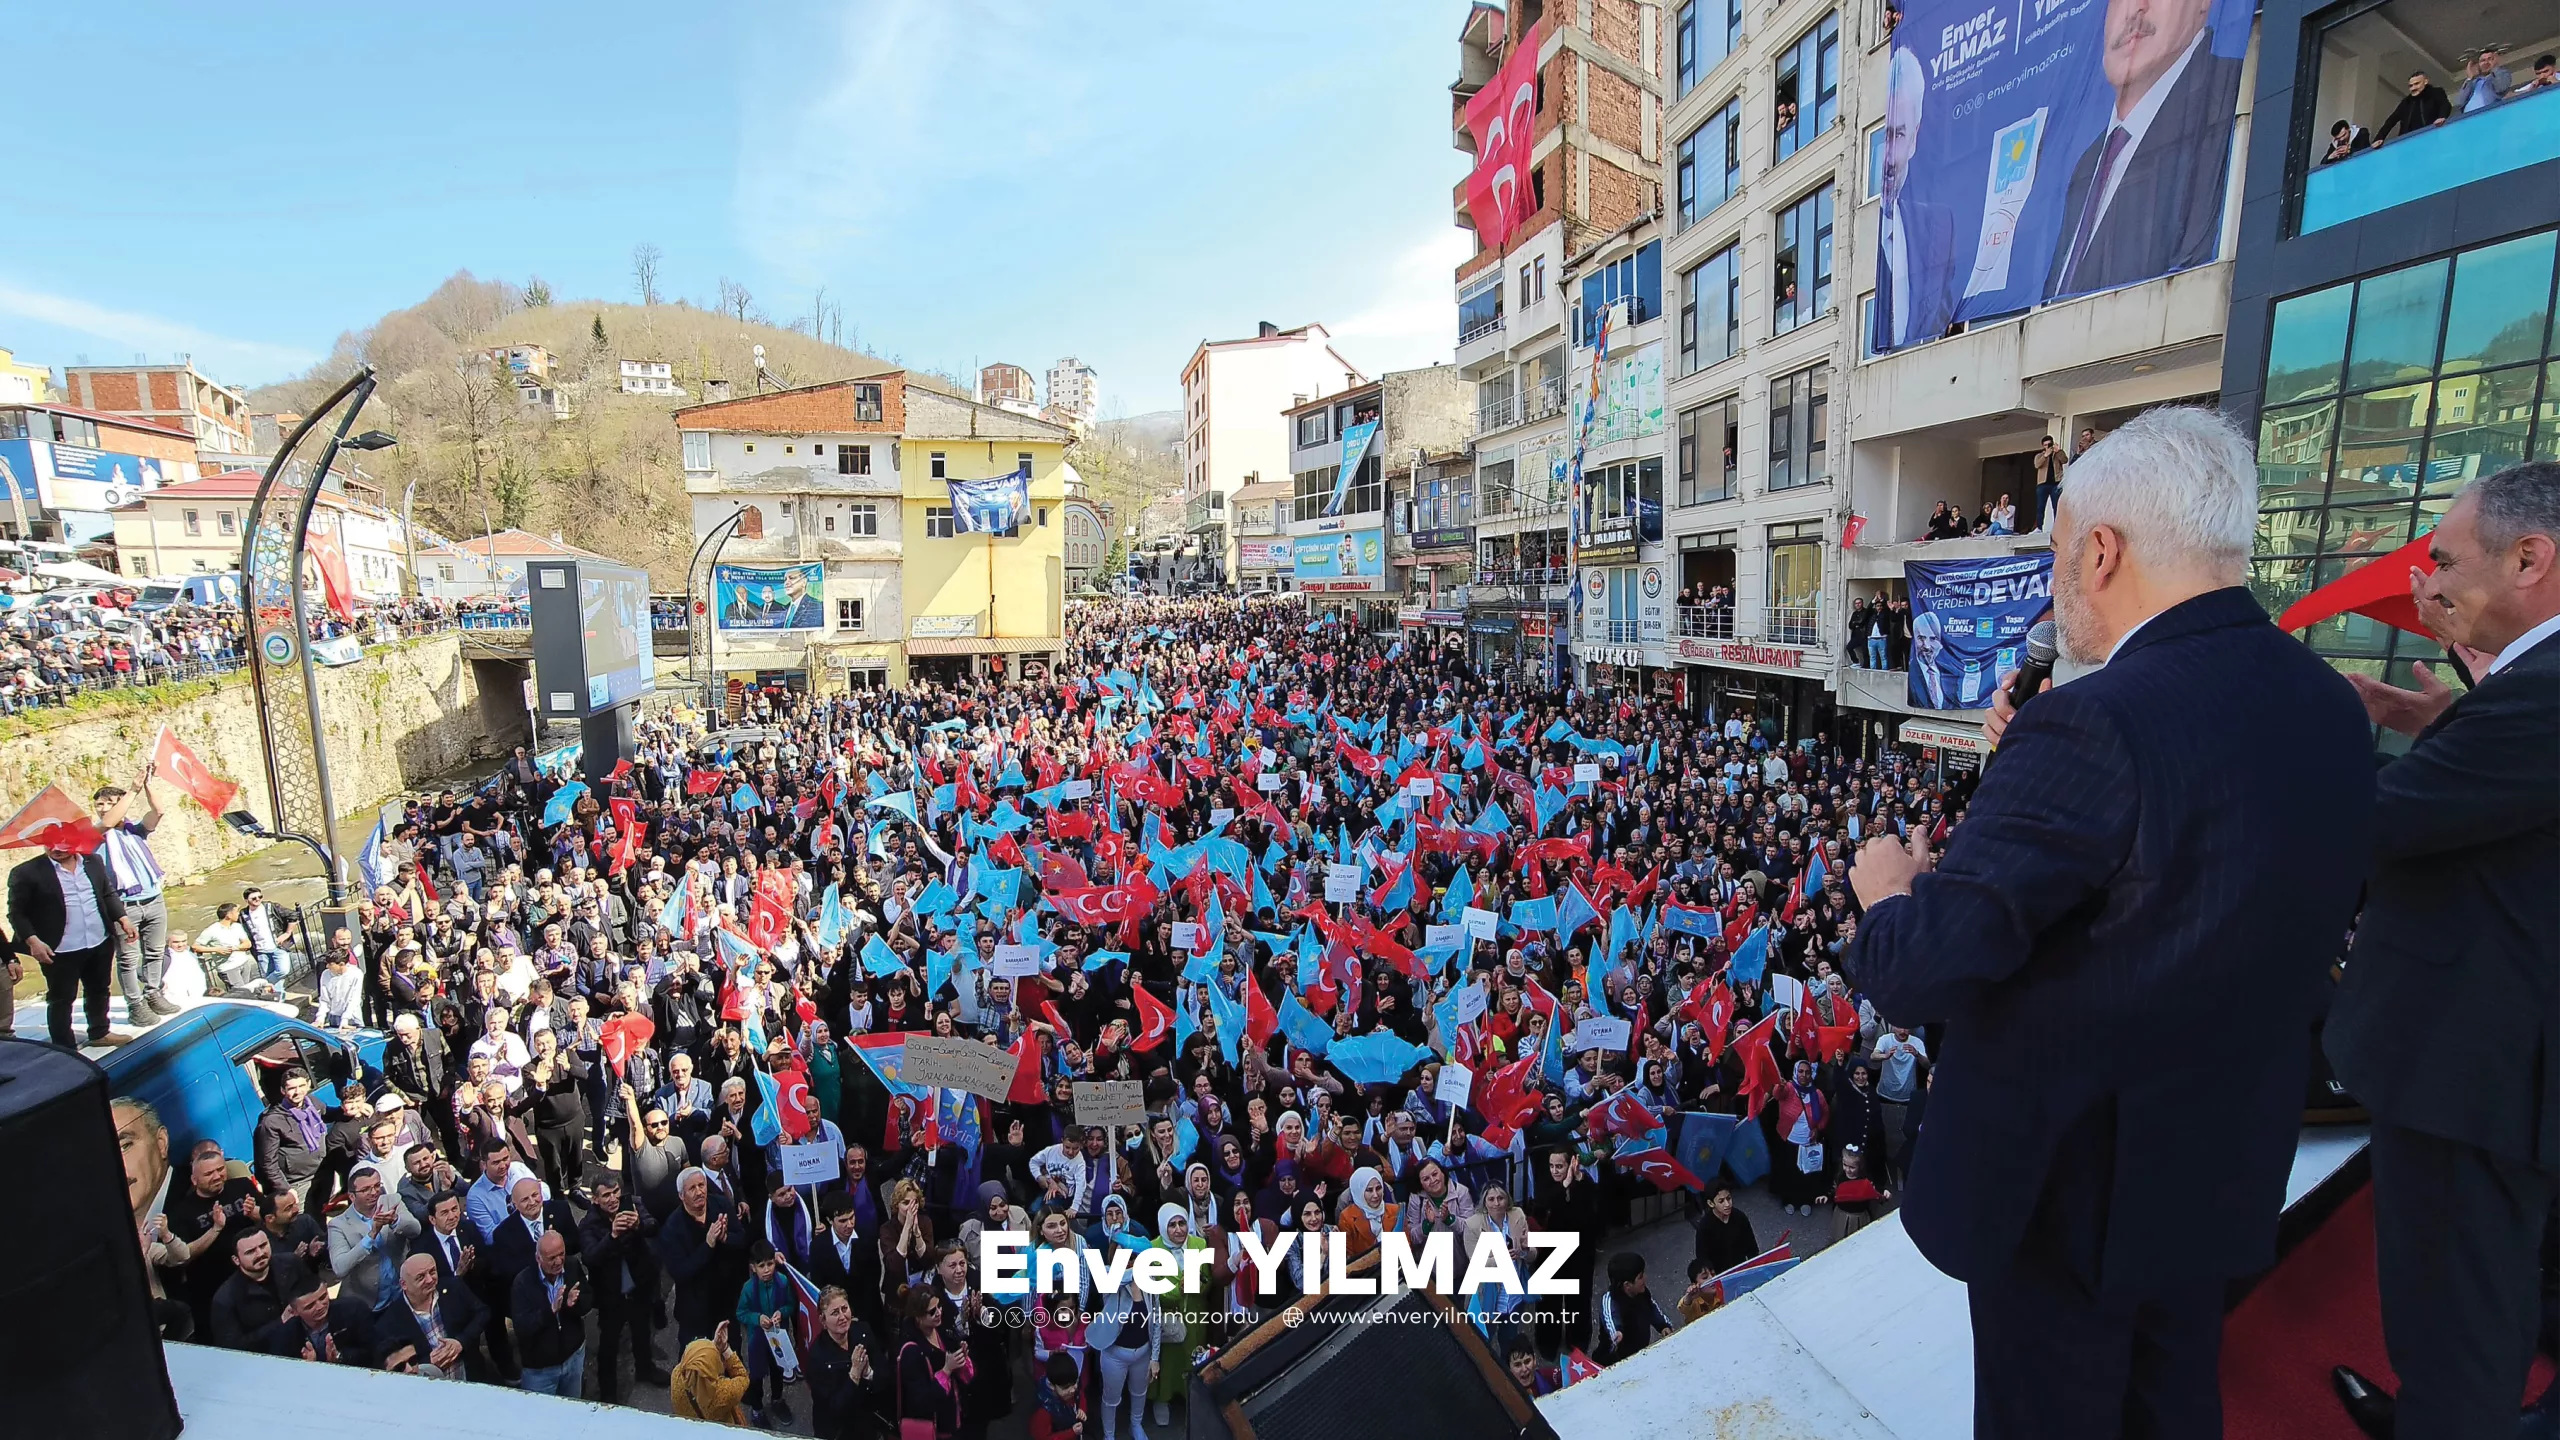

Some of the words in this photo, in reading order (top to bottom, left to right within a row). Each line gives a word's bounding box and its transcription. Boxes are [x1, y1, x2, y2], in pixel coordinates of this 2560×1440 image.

[1942, 6, 1996, 50] Enver
[1930, 17, 2007, 78] YILMAZ
[1987, 43, 2075, 100] enveryilmazordu
[1916, 583, 1972, 599] KALDIĞIMIZ
[1973, 572, 2054, 606] DEVA
[1931, 597, 1972, 610] YERDEN
[1944, 624, 1974, 633] YILMAZ
[1948, 617, 1970, 625] Enver
[1584, 646, 1639, 668] TUTKU
[1721, 644, 1804, 668] RESTAURANT
[1905, 730, 1933, 742] ÖZLEM
[1940, 735, 1976, 748] MATBAA
